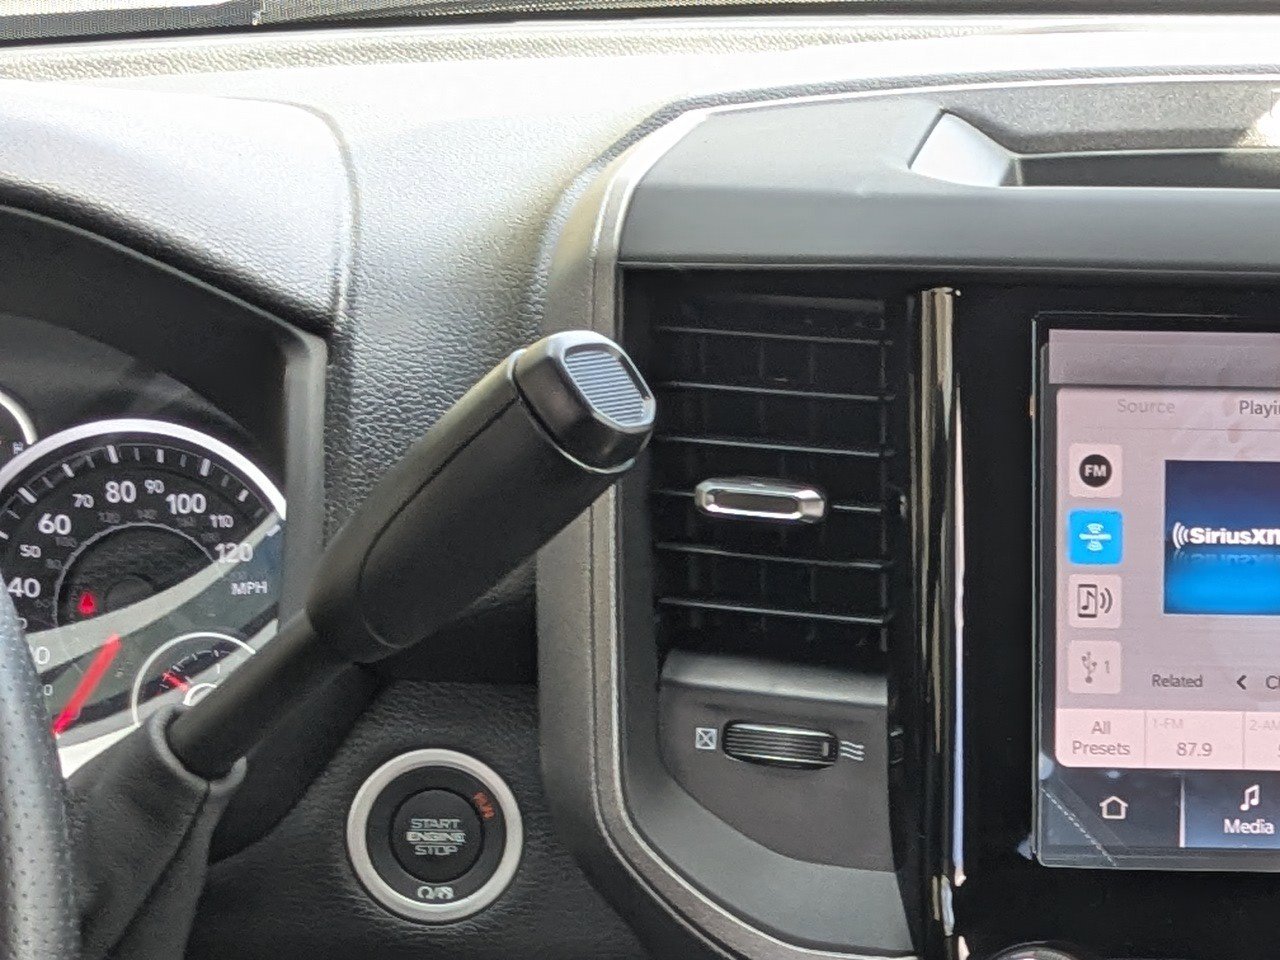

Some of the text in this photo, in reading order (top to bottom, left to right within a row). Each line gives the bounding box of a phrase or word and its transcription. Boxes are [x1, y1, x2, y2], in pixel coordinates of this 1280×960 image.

[1117, 399, 1176, 414] Source
[1085, 464, 1107, 477] FM
[105, 480, 137, 503] 80
[144, 479, 165, 494] 90
[72, 493, 95, 509] 70
[165, 493, 207, 515] 100
[38, 513, 72, 535] 60
[209, 514, 234, 528] 110
[20, 544, 42, 558] 50
[215, 542, 253, 563] 120
[6, 577, 41, 598] 40
[230, 581, 268, 595] MPH
[1152, 674, 1204, 689] Related
[1091, 720, 1111, 735] All
[1072, 740, 1131, 757] Presets
[1176, 742, 1213, 758] 87.9
[410, 818, 461, 829] START
[1223, 818, 1275, 835] Media
[406, 831, 466, 843] ENGINE
[414, 845, 458, 856] STOP
